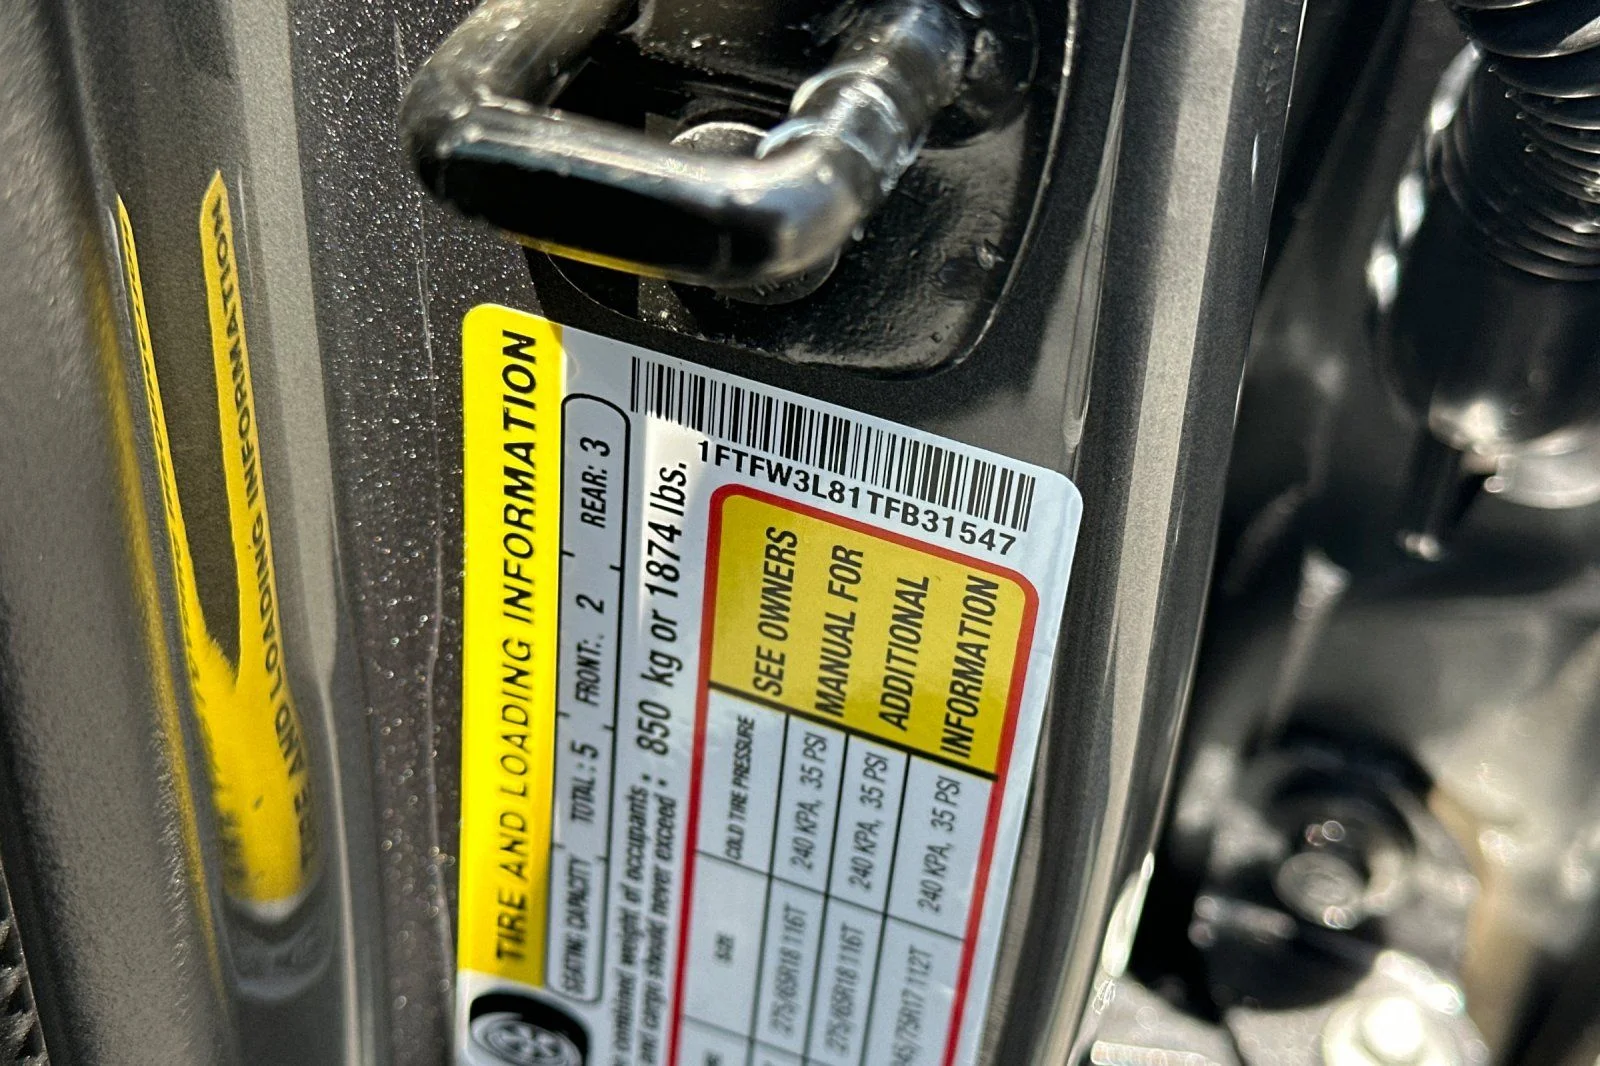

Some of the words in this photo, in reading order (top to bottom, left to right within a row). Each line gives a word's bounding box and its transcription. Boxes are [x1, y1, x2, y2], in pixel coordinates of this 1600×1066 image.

[580, 436, 610, 458] 3
[502, 329, 537, 624] INFORMATION
[649, 462, 688, 517] lbs.
[581, 464, 609, 529] REAR:
[697, 439, 1017, 556] 1FTFW3L81TFB31547
[645, 520, 683, 599] 1874
[828, 544, 865, 603] FOR
[576, 593, 604, 614] 2
[757, 525, 799, 644] OWNERS
[649, 608, 679, 644] or
[640, 649, 684, 688] kg
[753, 645, 786, 698] SEE
[815, 612, 856, 718] MANUAL
[878, 575, 930, 731] ADDITIONAL
[940, 574, 1000, 759] INFORMATION
[500, 635, 533, 797] LOADING
[635, 700, 672, 758] 850
[571, 741, 599, 760] 5
[732, 715, 756, 787] PRESSURE
[802, 731, 828, 764] PSI
[800, 763, 824, 790] 35
[862, 751, 889, 784] PSI
[729, 787, 750, 823] TIRE
[859, 783, 885, 810] 35
[934, 775, 962, 807] PSI
[624, 784, 650, 883] occupants
[795, 800, 823, 836] KPA,
[853, 819, 883, 856] KPA,
[930, 807, 956, 833] 35
[499, 811, 531, 880] AND
[724, 822, 745, 861] COLD
[790, 836, 816, 871] 240
[924, 842, 954, 878] KPA,
[651, 868, 672, 918] never
[848, 856, 874, 891] 240
[623, 882, 641, 905] of
[917, 878, 943, 914] 240
[496, 888, 527, 962] TIRE
